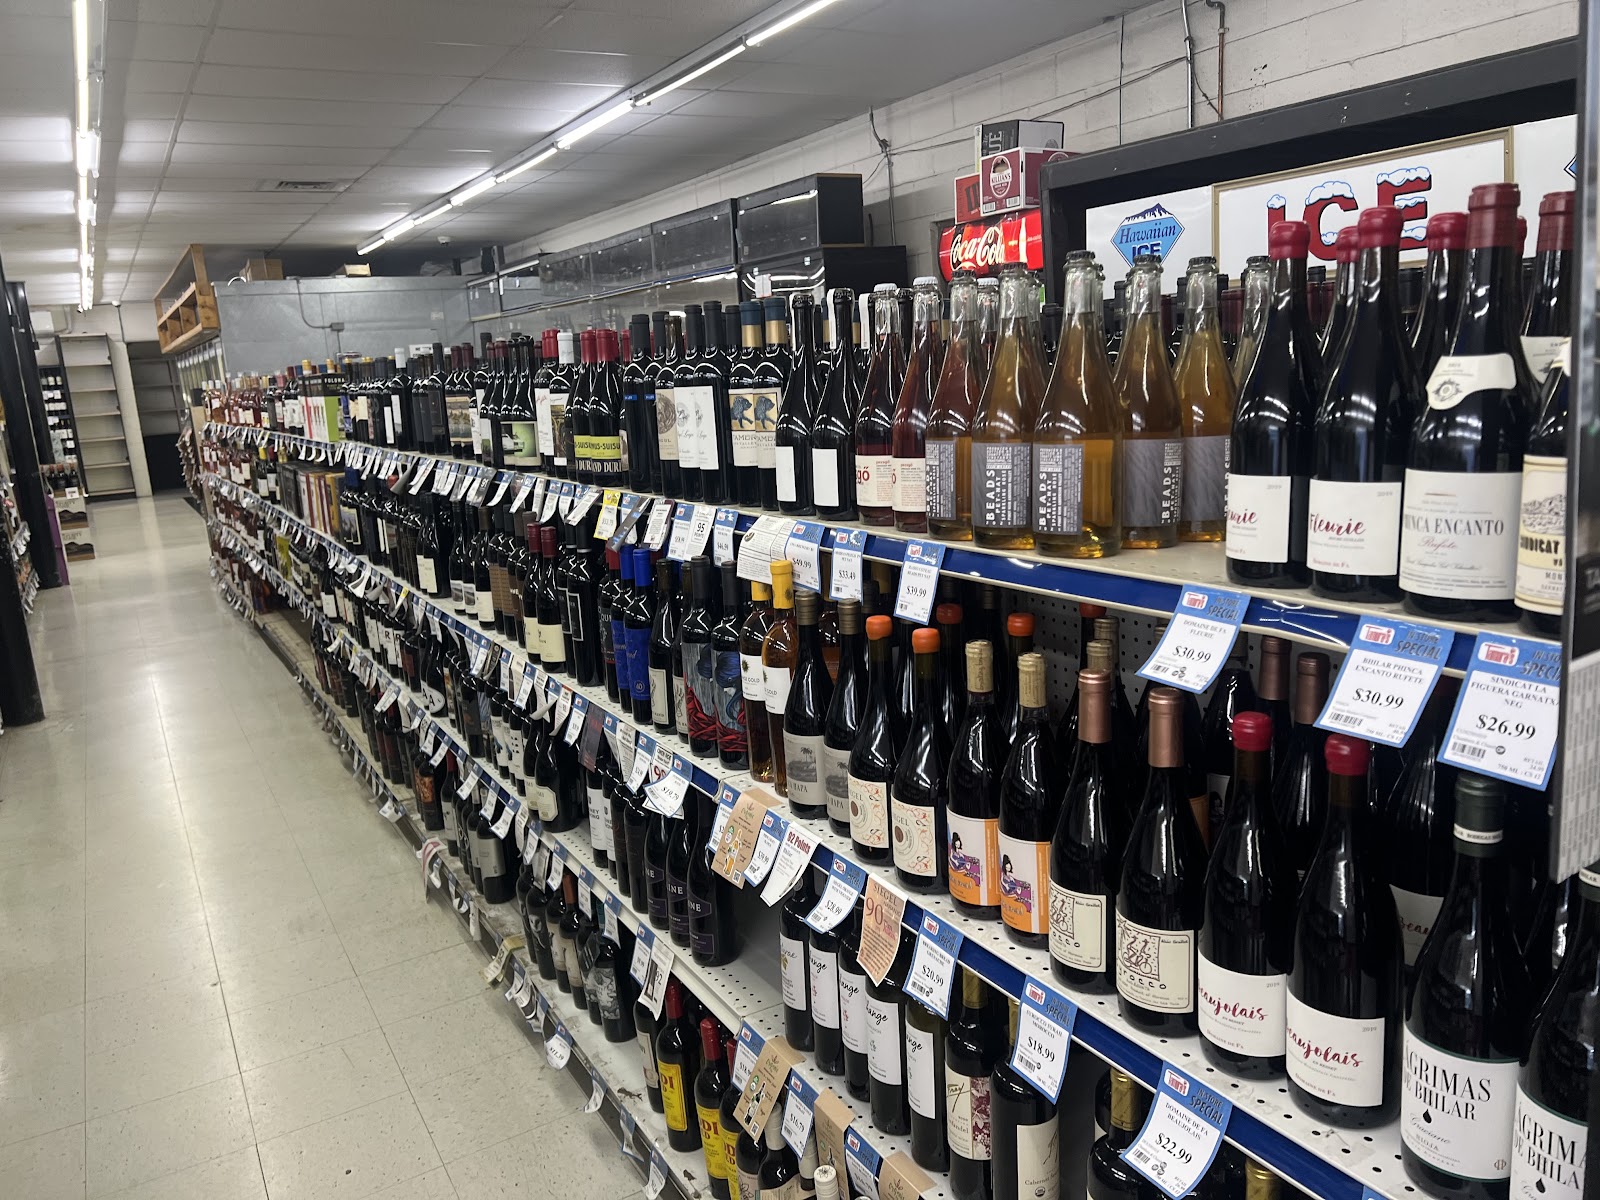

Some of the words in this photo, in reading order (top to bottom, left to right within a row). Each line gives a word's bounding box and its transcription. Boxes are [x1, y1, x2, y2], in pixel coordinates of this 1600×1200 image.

[1118, 221, 1177, 245] Hawaiian
[986, 469, 996, 521] BEADS
[1039, 472, 1047, 526] BEADS
[1161, 467, 1172, 519] BEADS
[697, 522, 706, 533] 95
[1227, 509, 1259, 524] urie
[1309, 513, 1367, 536] Fleurie
[1434, 518, 1504, 536] ENCANTO
[906, 585, 927, 598] $39.99
[1183, 619, 1209, 630] DOMAINE
[1207, 605, 1240, 621] SPECIAL
[1172, 645, 1212, 664] $30.99
[1394, 640, 1442, 660] SPECIAL
[1355, 664, 1392, 678] ENCANTO
[1392, 672, 1424, 685] RUFETE
[1362, 657, 1392, 670] BHILAR
[1393, 663, 1423, 676] PHINCA
[1520, 661, 1561, 682] SPECI
[1470, 682, 1509, 697] FIGUERA
[1490, 676, 1533, 690] SINDICAT
[1534, 684, 1548, 694] LA
[1352, 687, 1404, 710] $30.99
[1504, 698, 1523, 709] NEG
[1475, 714, 1536, 741] $26.99
[794, 835, 811, 855] Points
[873, 882, 898, 907] SIEGEL
[865, 896, 884, 926] 90
[921, 964, 944, 987] $20.99
[1045, 1003, 1071, 1028] SPECIAL
[1362, 1025, 1377, 1033] 2019
[1027, 1036, 1056, 1063] $18.99
[1404, 1040, 1491, 1103] ÁGRIMAS
[1189, 1095, 1224, 1126] SPECIAL
[1415, 1081, 1477, 1122] BHILAR
[1165, 1102, 1192, 1124] DOMAINE
[1191, 1119, 1200, 1129] DE
[1200, 1124, 1209, 1137] FA
[1167, 1113, 1202, 1141] BEAUJOLAIS
[1155, 1131, 1193, 1166] $22.99
[1527, 1150, 1580, 1190] BHILA
